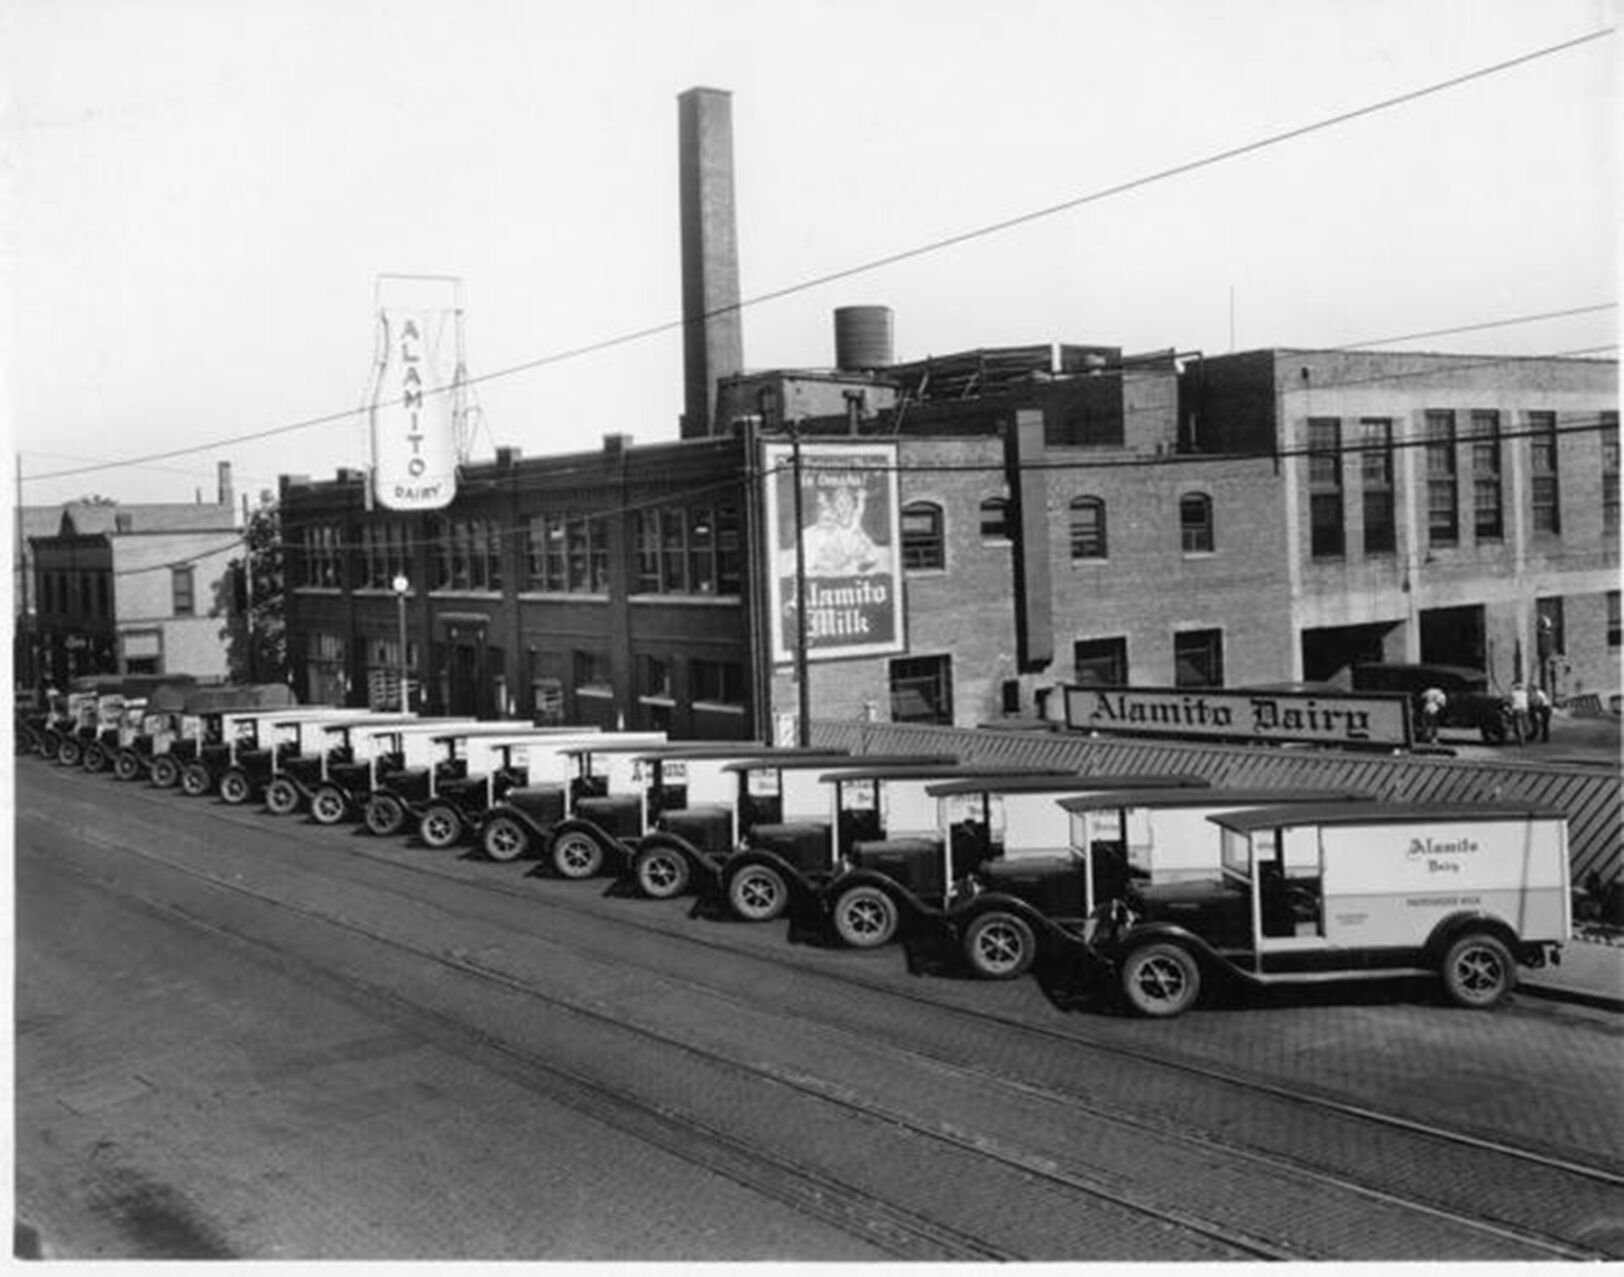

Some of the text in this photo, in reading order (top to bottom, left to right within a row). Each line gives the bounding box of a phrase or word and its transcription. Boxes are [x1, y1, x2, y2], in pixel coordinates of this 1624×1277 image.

[401, 319, 426, 477] ALAMITO
[394, 482, 442, 500] DAIRY
[804, 608, 869, 638] Milk
[1089, 692, 1370, 739] Alamito Dairy
